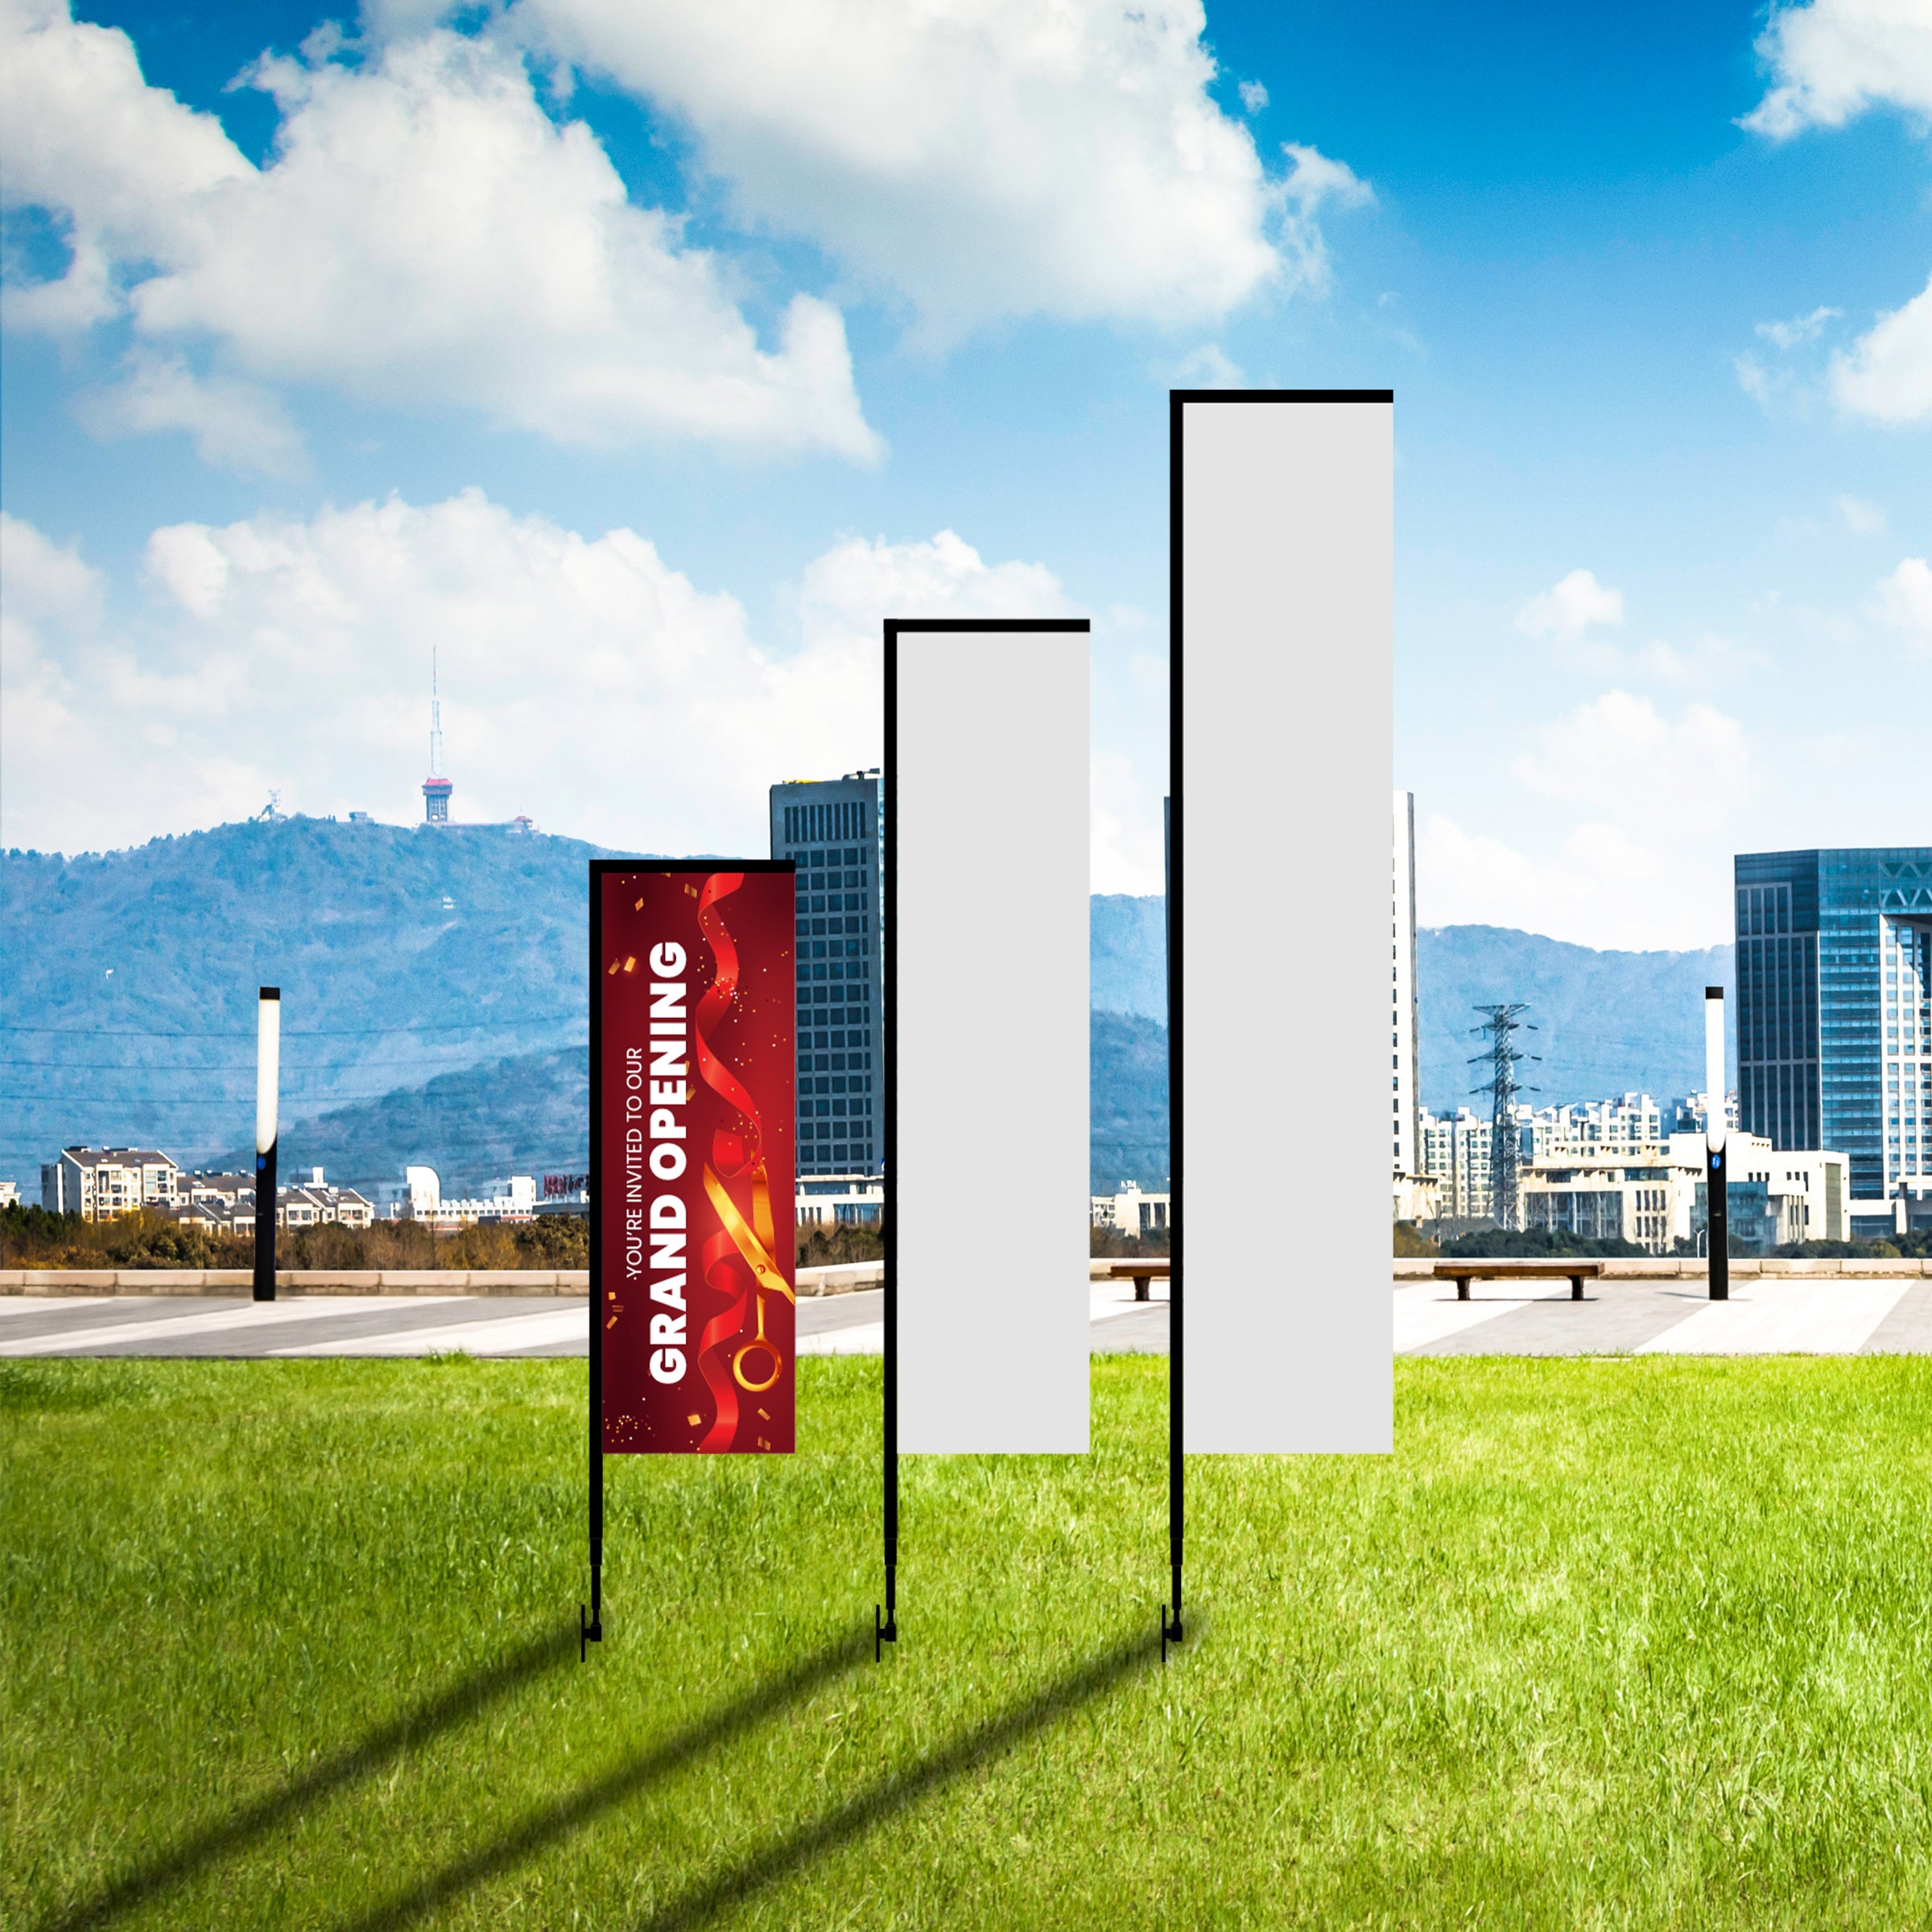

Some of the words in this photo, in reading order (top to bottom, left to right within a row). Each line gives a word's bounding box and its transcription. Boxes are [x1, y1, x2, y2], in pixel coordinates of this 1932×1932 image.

[626, 1047, 642, 1090] OUR
[649, 942, 687, 1181] OPENING
[626, 1096, 642, 1123] TO
[626, 1129, 642, 1203] INVITED
[626, 1208, 642, 1280] YOU'RE
[649, 1194, 687, 1385] GRAND
